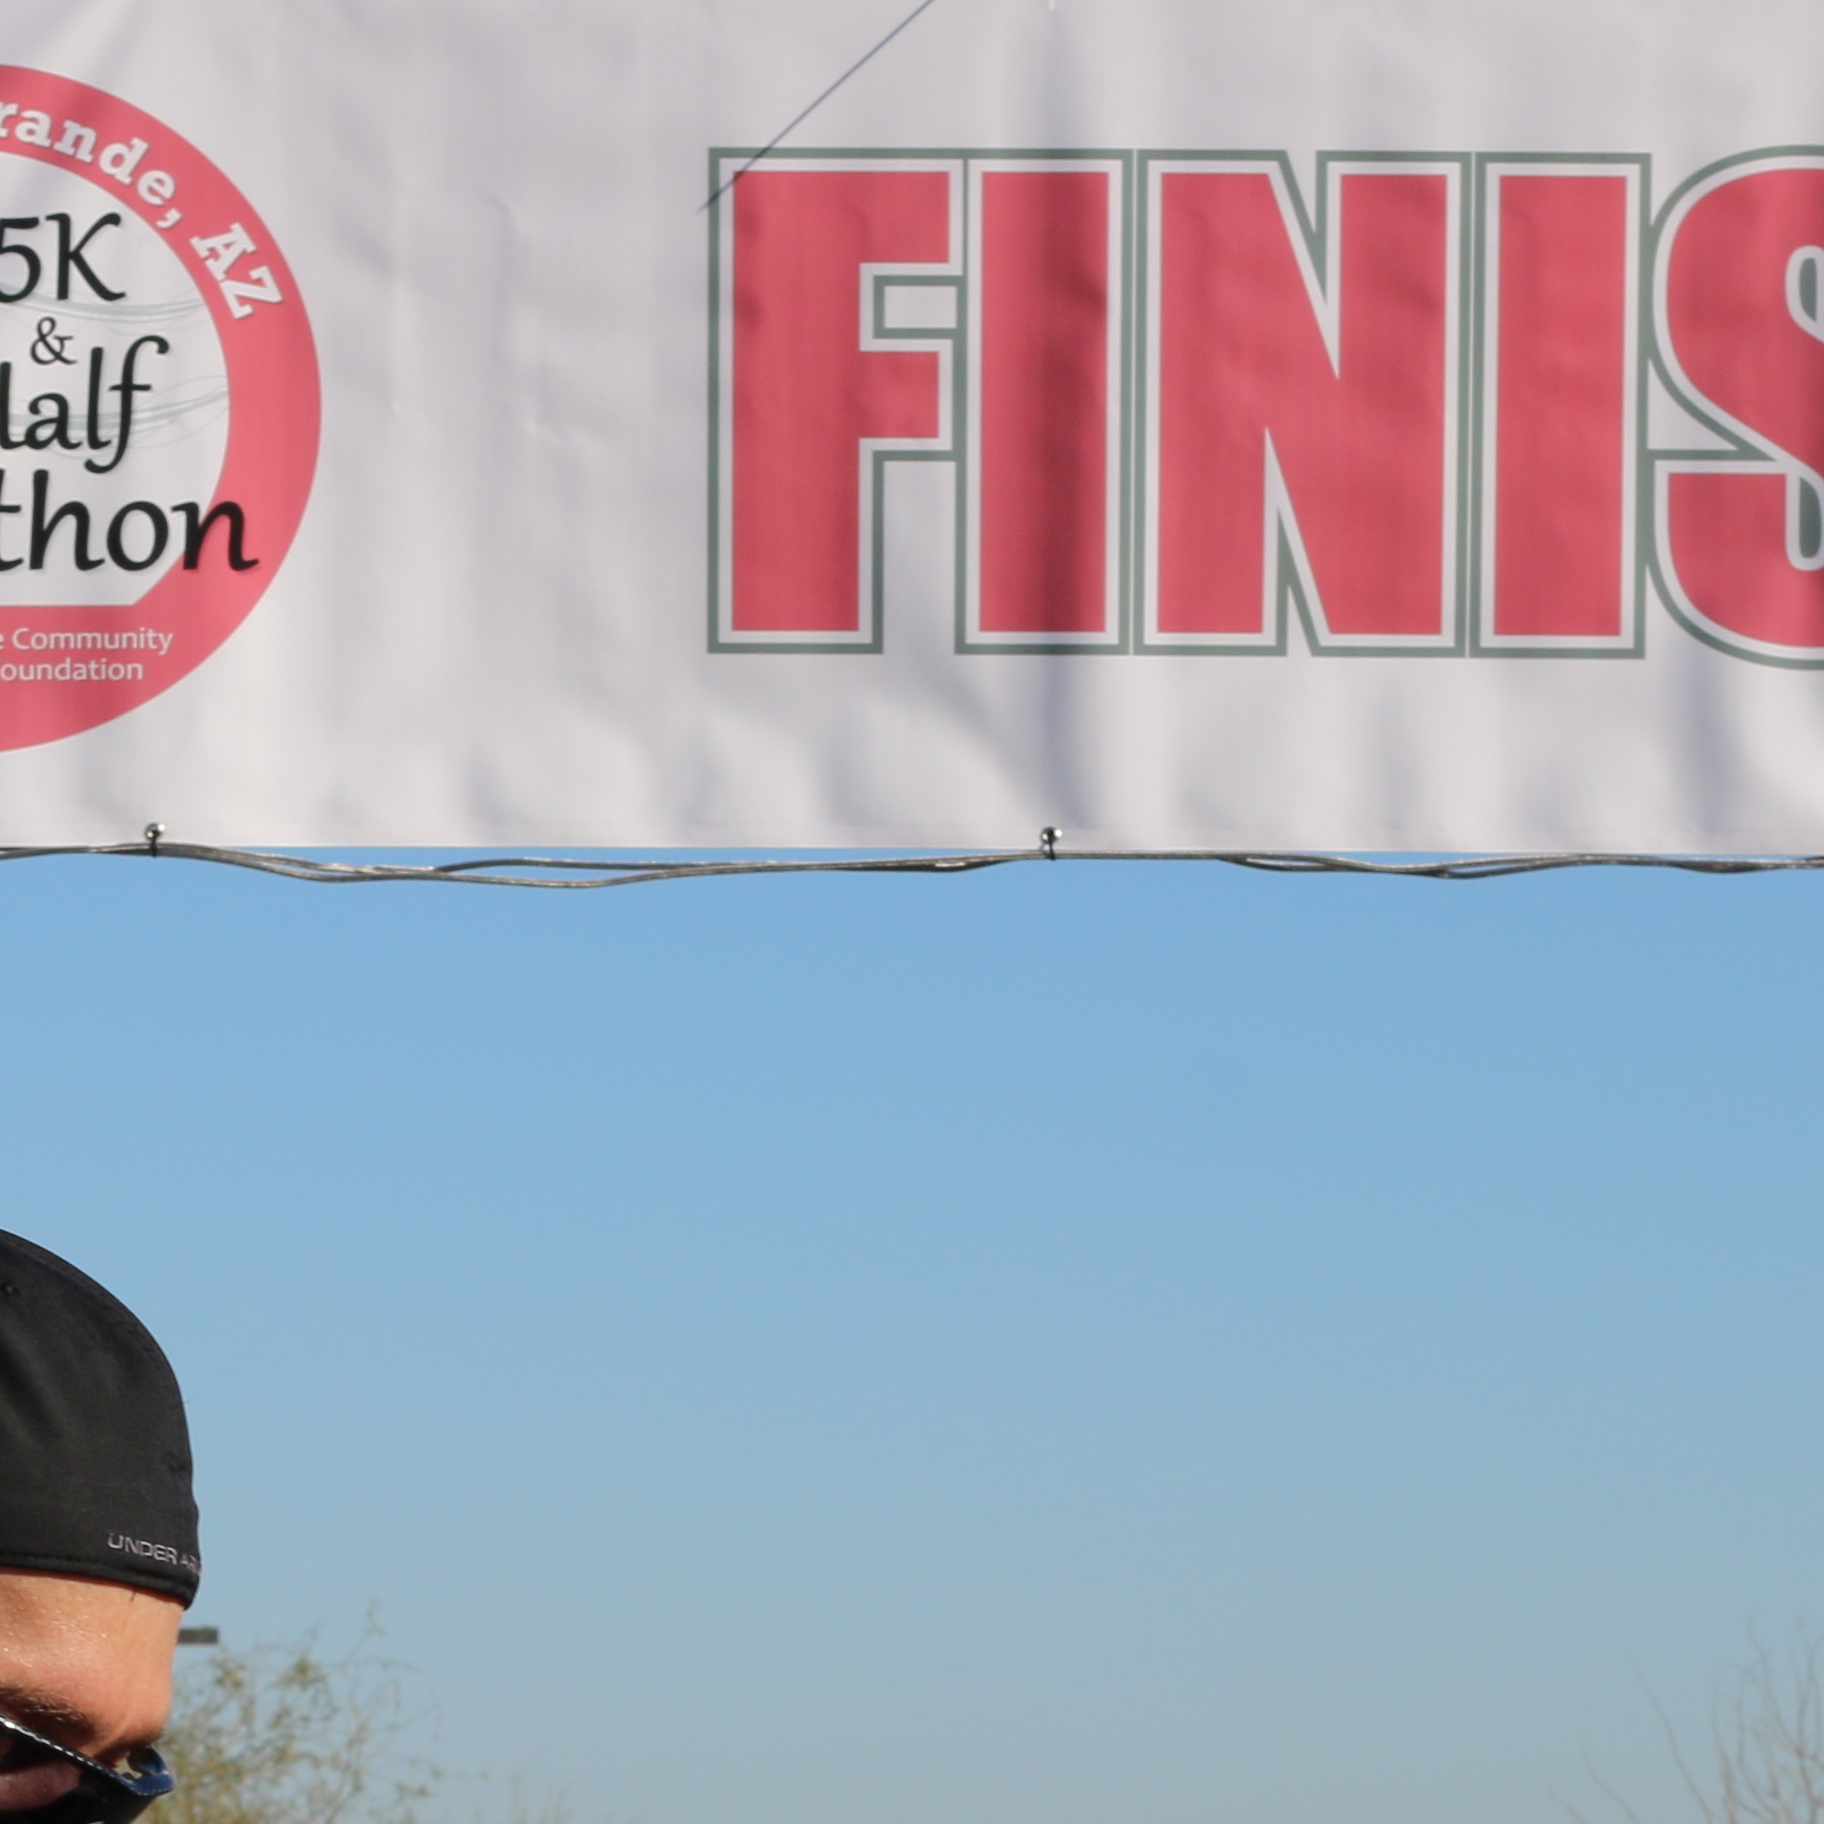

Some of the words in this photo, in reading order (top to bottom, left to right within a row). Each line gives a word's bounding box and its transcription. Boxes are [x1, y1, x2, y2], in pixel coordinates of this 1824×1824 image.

[190, 223, 283, 319] AZ
[30, 317, 77, 365] &
[12, 626, 173, 655] Community
[108, 1533, 177, 1564] UNDER
